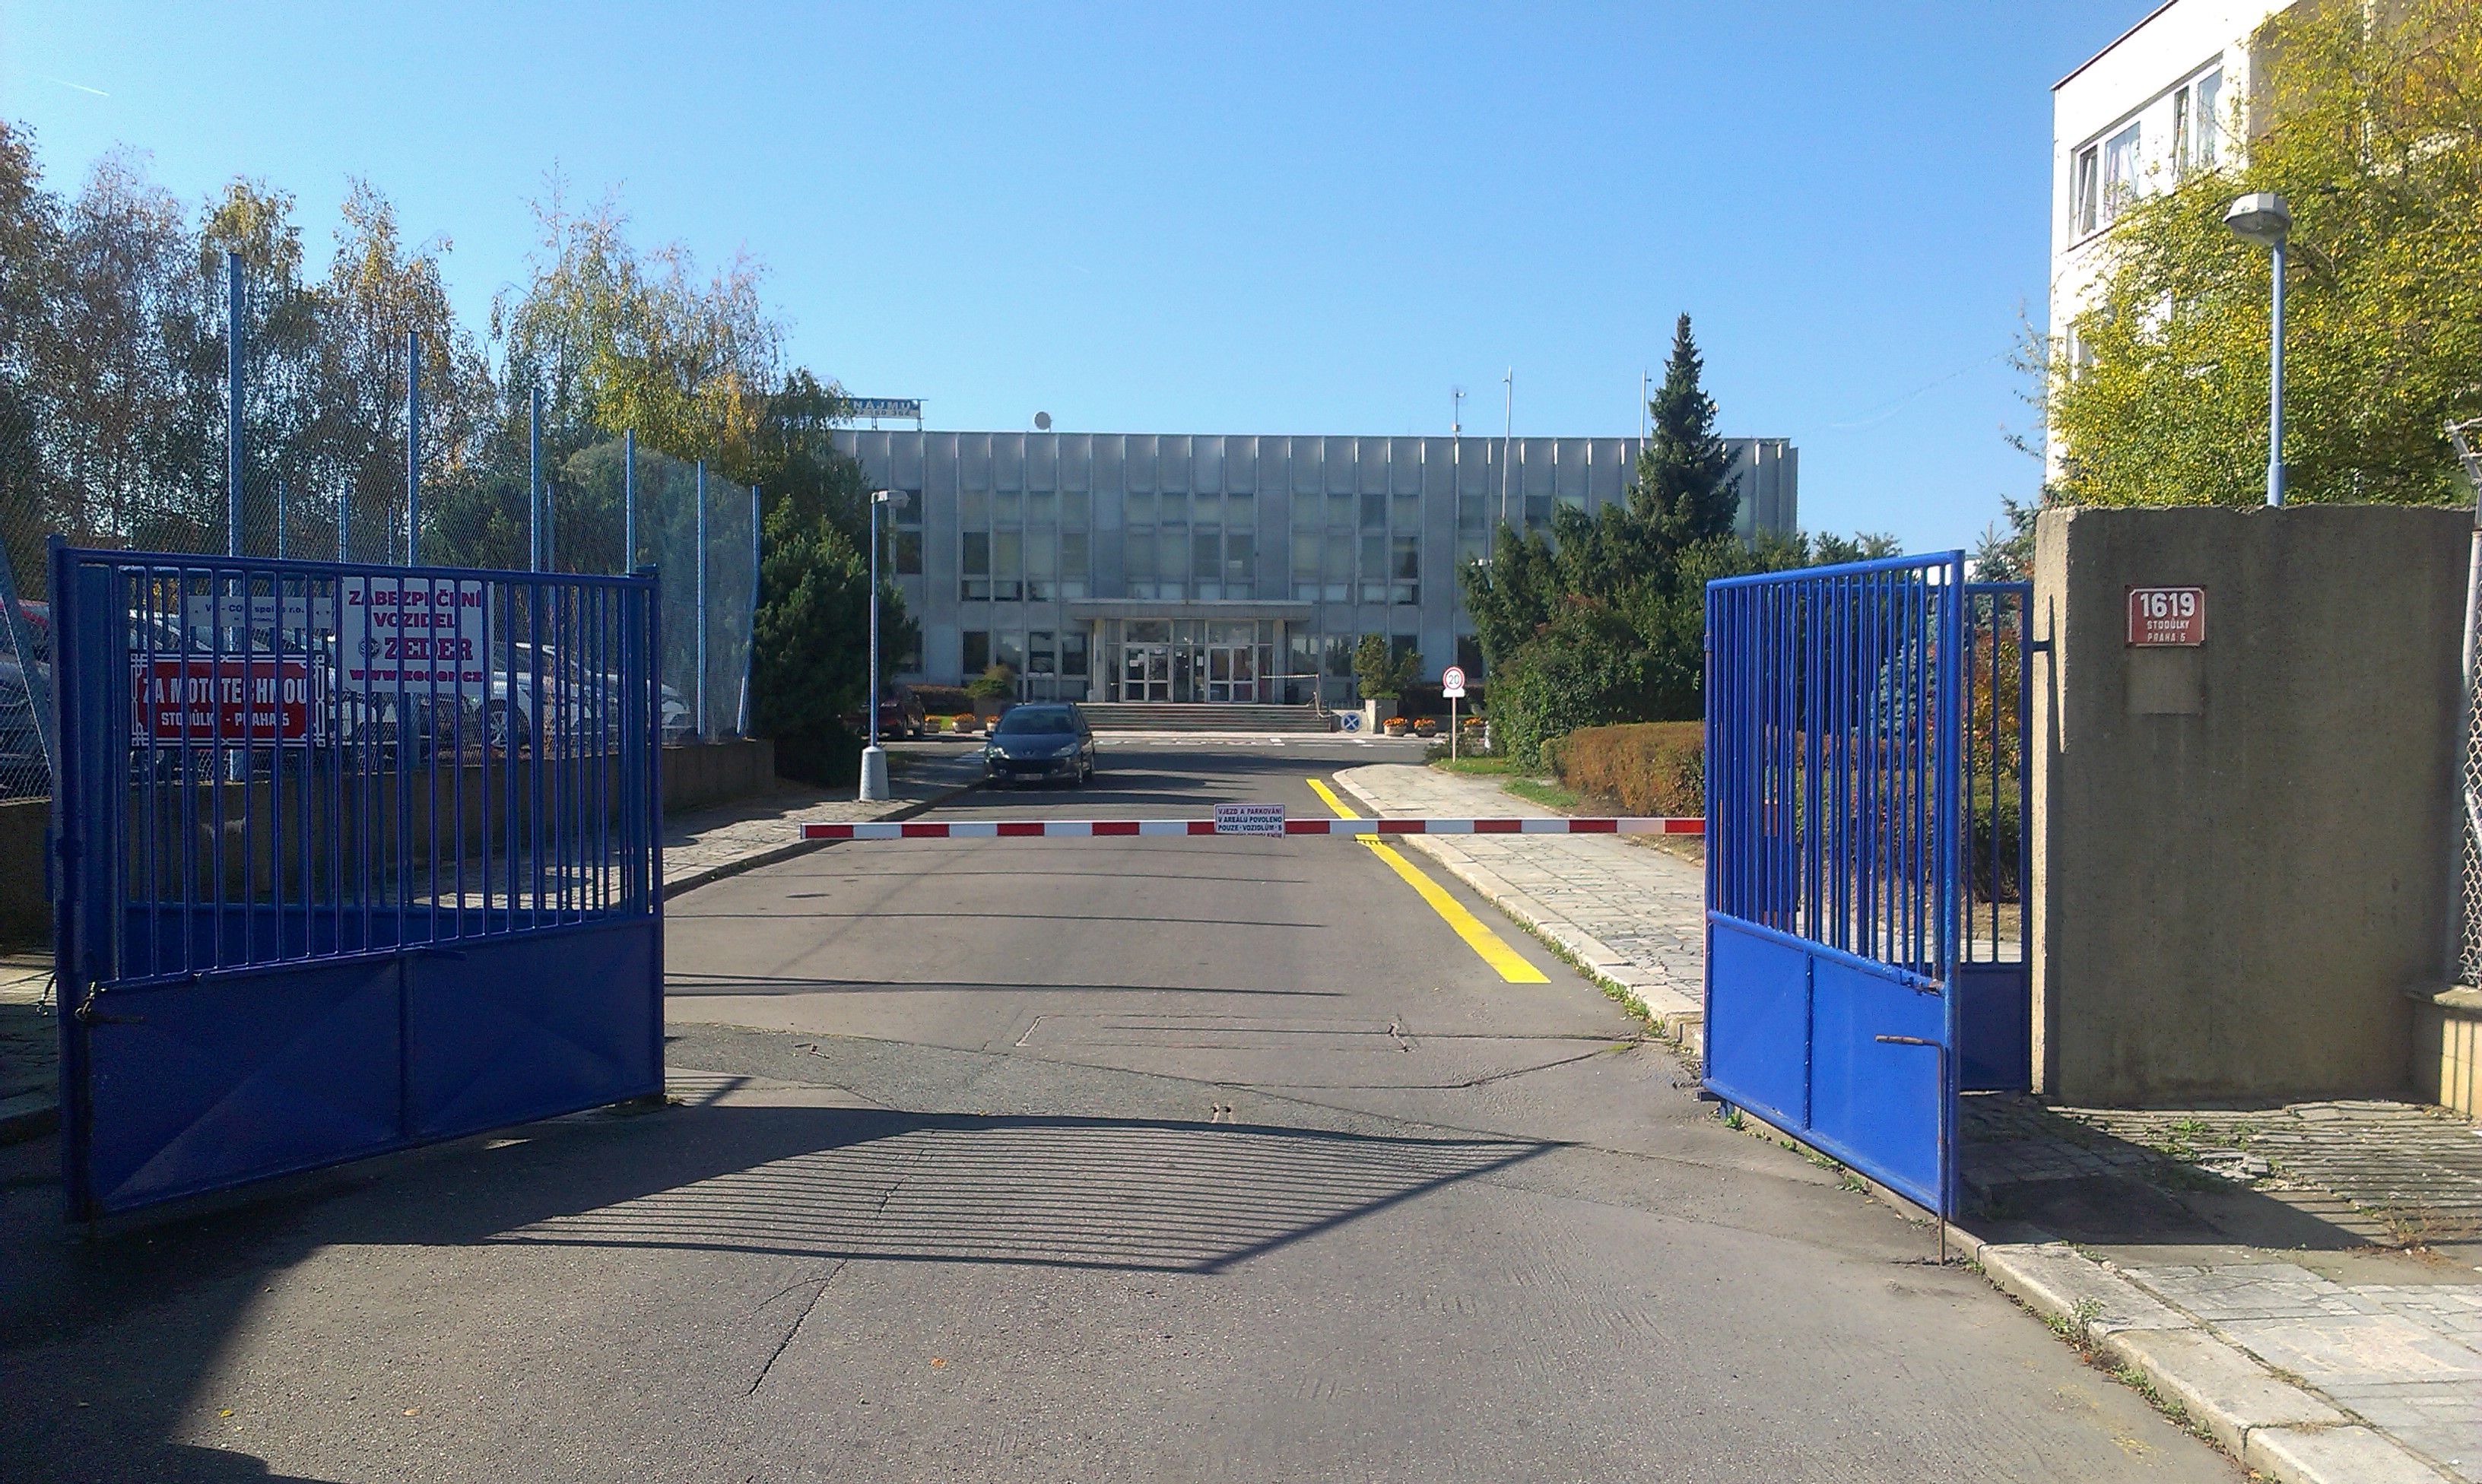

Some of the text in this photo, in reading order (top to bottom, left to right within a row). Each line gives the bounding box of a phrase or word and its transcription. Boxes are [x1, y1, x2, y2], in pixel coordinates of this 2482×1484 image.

[2141, 592, 2195, 617] 1619
[373, 613, 455, 628] VOZIDEL
[2147, 617, 2190, 630] STODŮLKY
[2147, 633, 2187, 642] PRAHA 5
[385, 637, 473, 661] ZEDER
[1449, 674, 1459, 685] 20
[234, 712, 277, 727] PAHA
[282, 712, 290, 727] 5
